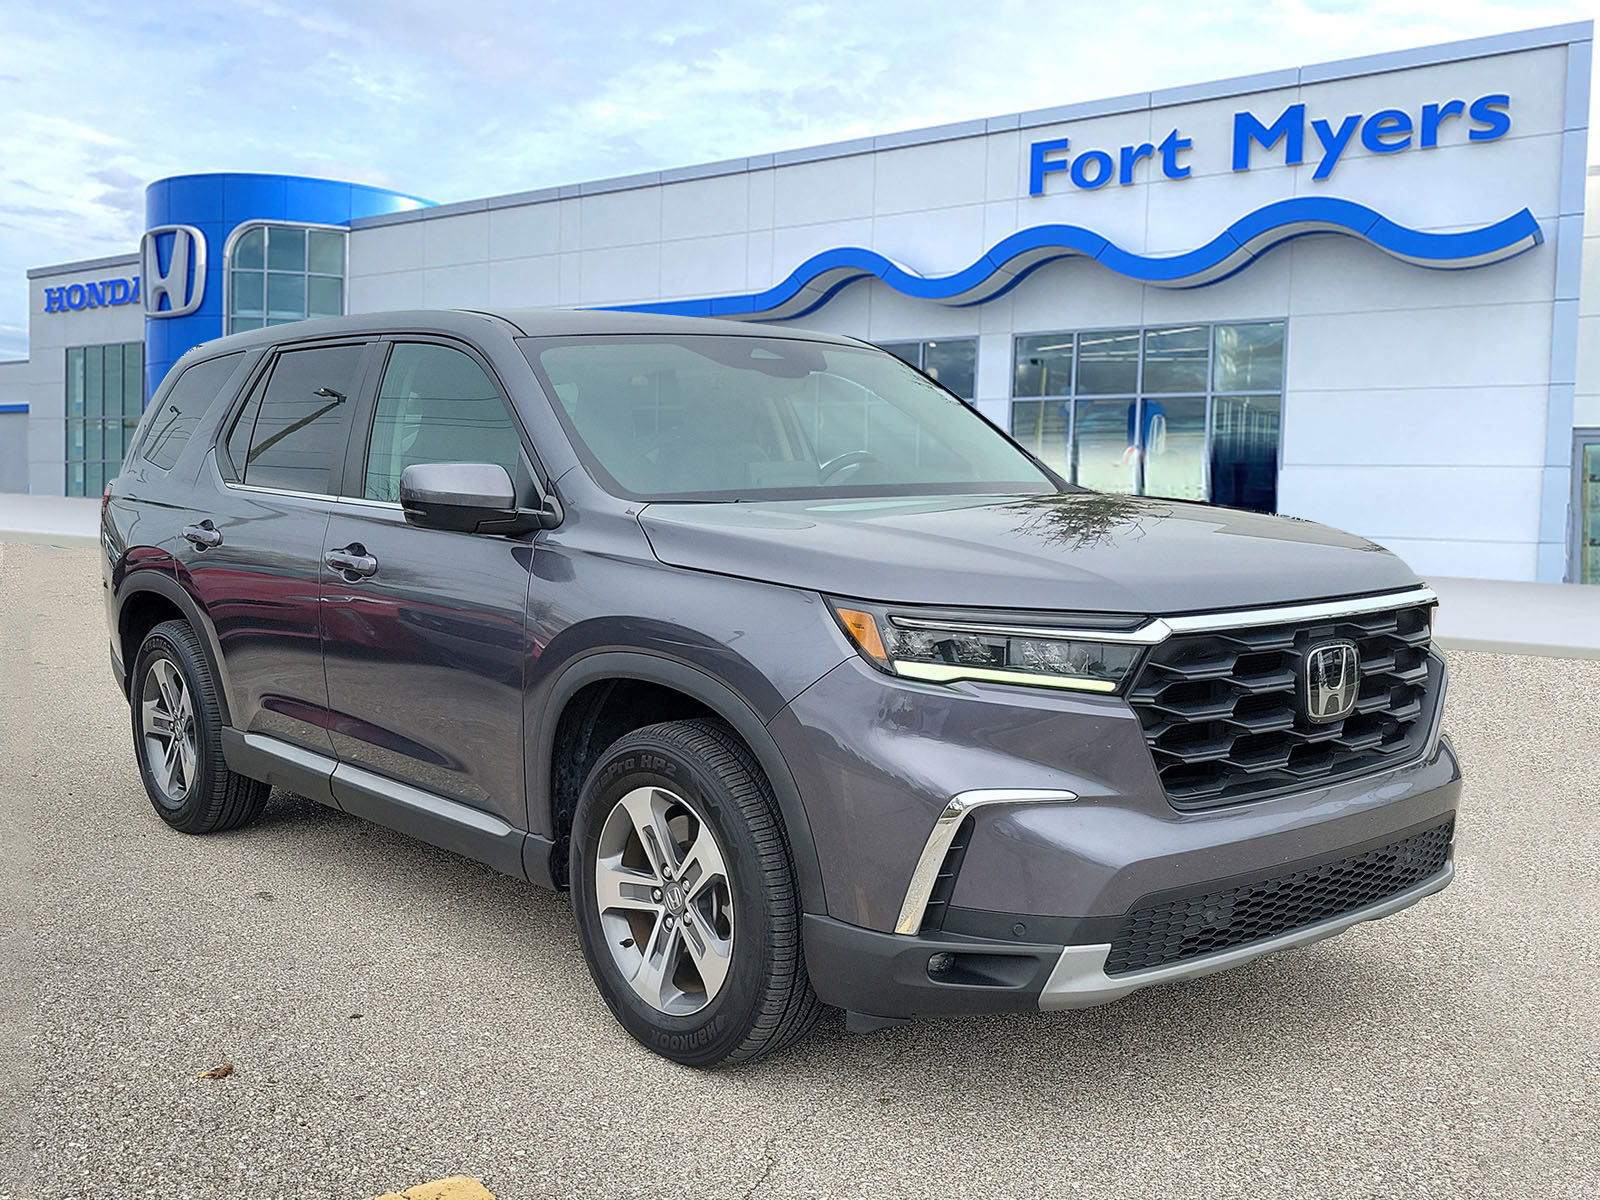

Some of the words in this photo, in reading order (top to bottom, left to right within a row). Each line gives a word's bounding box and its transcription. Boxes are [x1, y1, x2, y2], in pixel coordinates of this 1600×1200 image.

[1029, 128, 1193, 196] Fort
[1233, 93, 1511, 180] Myers
[640, 754, 677, 777] HP2
